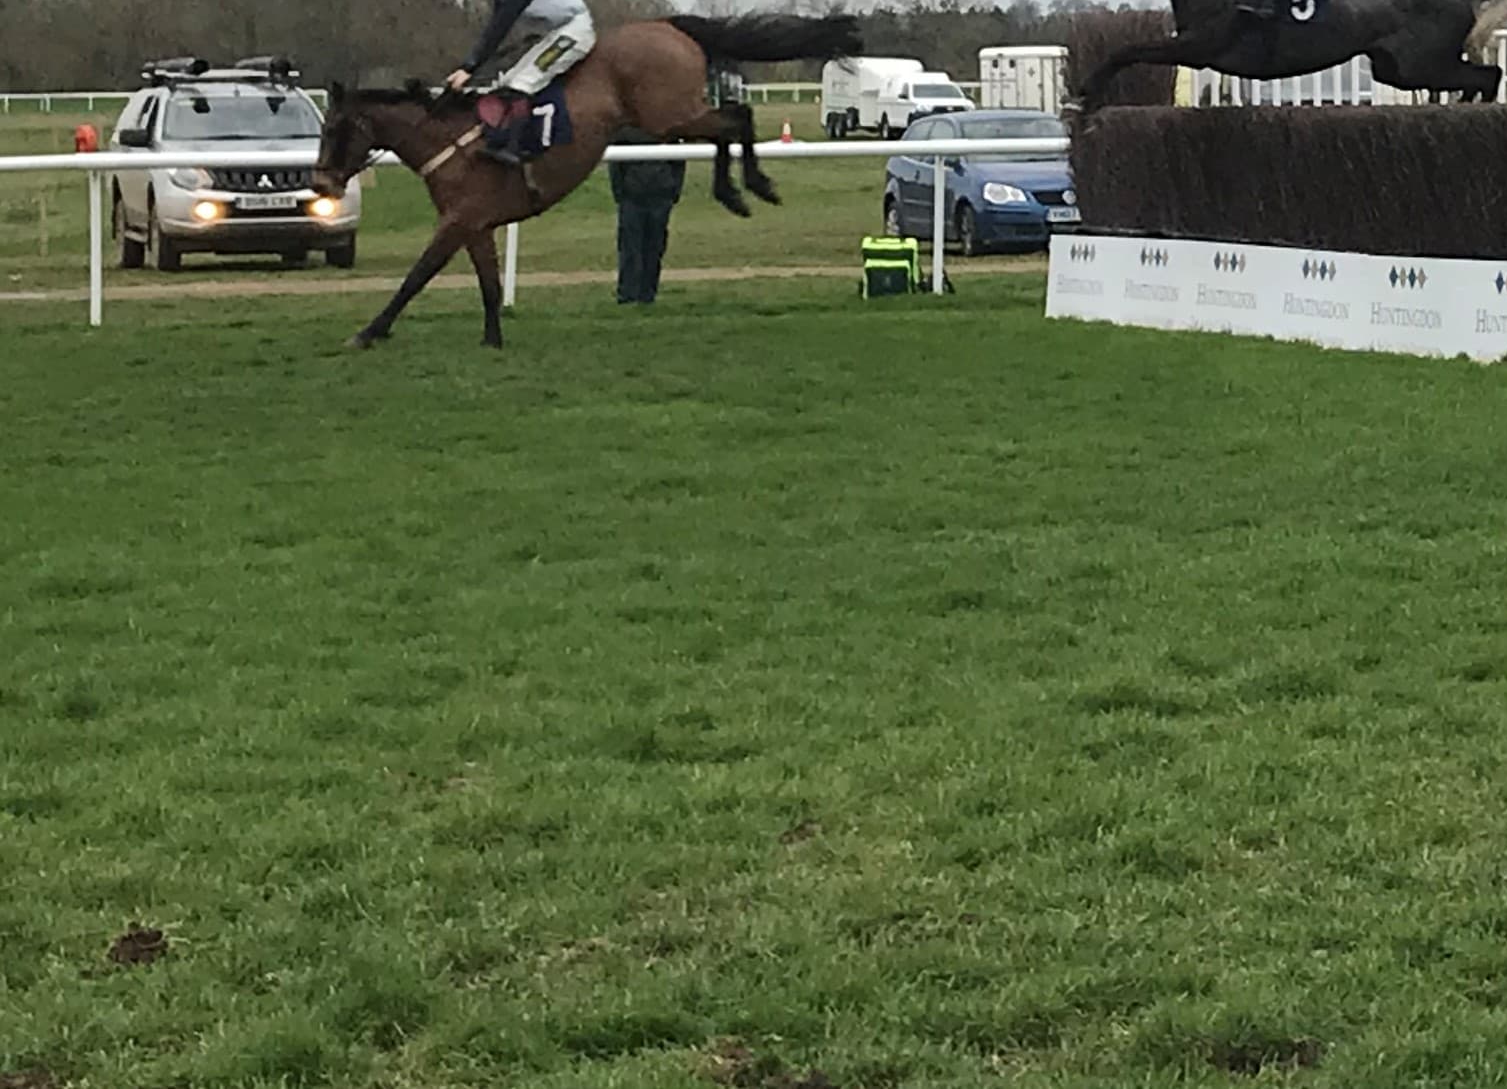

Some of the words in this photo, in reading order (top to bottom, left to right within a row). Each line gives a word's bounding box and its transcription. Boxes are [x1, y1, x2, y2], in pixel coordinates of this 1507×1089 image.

[532, 103, 555, 146] 7
[1284, 292, 1350, 319] HUNTINGDON
[1370, 301, 1442, 329] HUNTINGDON
